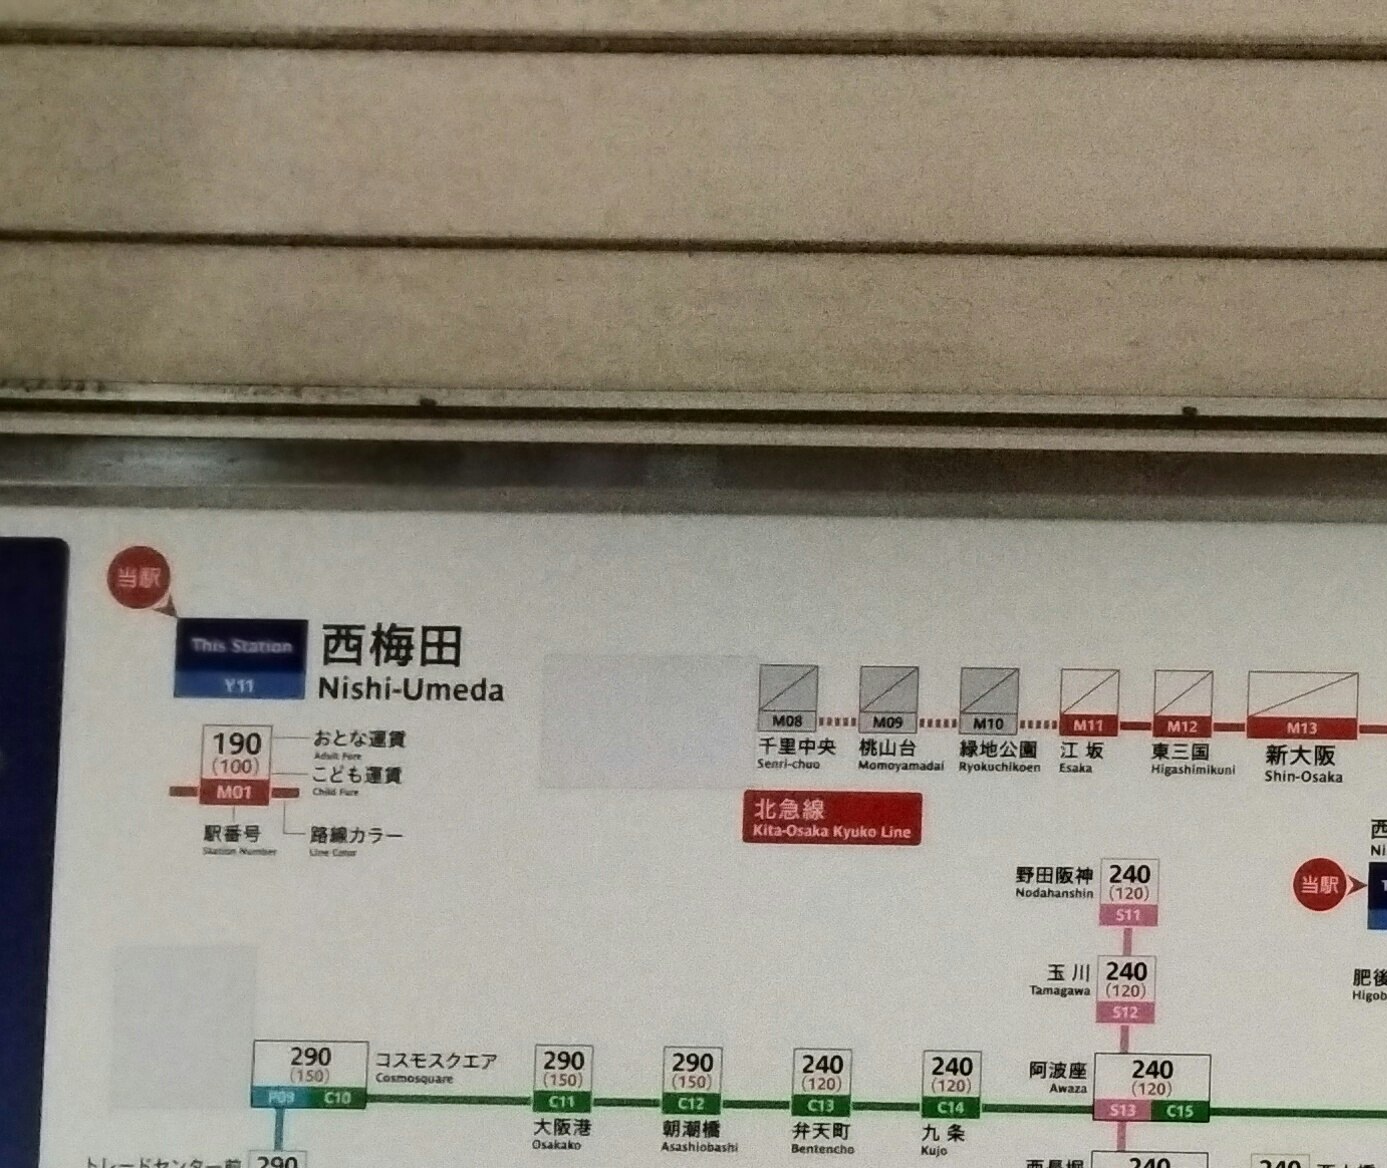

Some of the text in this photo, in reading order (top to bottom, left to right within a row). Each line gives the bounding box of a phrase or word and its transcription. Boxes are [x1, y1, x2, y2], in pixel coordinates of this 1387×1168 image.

[192, 638, 291, 652] This Station
[323, 623, 461, 667] 西梅田
[225, 679, 253, 692] Y11
[319, 676, 503, 701] Nishi-Umeda
[1074, 720, 1102, 731] M11
[1168, 721, 1197, 732] M12
[1288, 722, 1317, 734] M13
[214, 733, 261, 755] 190
[314, 730, 405, 748] おとな運賃
[760, 737, 836, 755] 千里中央
[859, 738, 916, 756] 桃山台
[960, 740, 1037, 758] 緑地公園
[1152, 743, 1209, 760] 東三国
[1266, 745, 1335, 766] 新大阪
[213, 757, 259, 776] (100)
[758, 759, 820, 769] Senri-chuo
[859, 761, 944, 772] Momoyamadai
[959, 762, 1040, 773] Ryokuchikoen
[1059, 763, 1092, 773] Esaka
[1152, 764, 1235, 777] Higashimikuni
[313, 767, 401, 784] こども運賃
[1265, 770, 1342, 783] Shin-Osaka
[217, 785, 251, 799] M01
[755, 799, 823, 820] 北急線
[204, 825, 260, 842] 駅番号
[311, 826, 402, 843] 路線カラー
[753, 824, 911, 840] Kita-Osaka Kyuko Line
[1016, 867, 1093, 884] 野田阪神
[1016, 888, 1093, 898] Nodahanshin
[1299, 874, 1338, 896] 当駅
[377, 1053, 497, 1069] コスモスクエア
[549, 1096, 574, 1108] C11
[534, 1118, 591, 1136] 大阪港
[532, 1140, 581, 1150] Osakako
